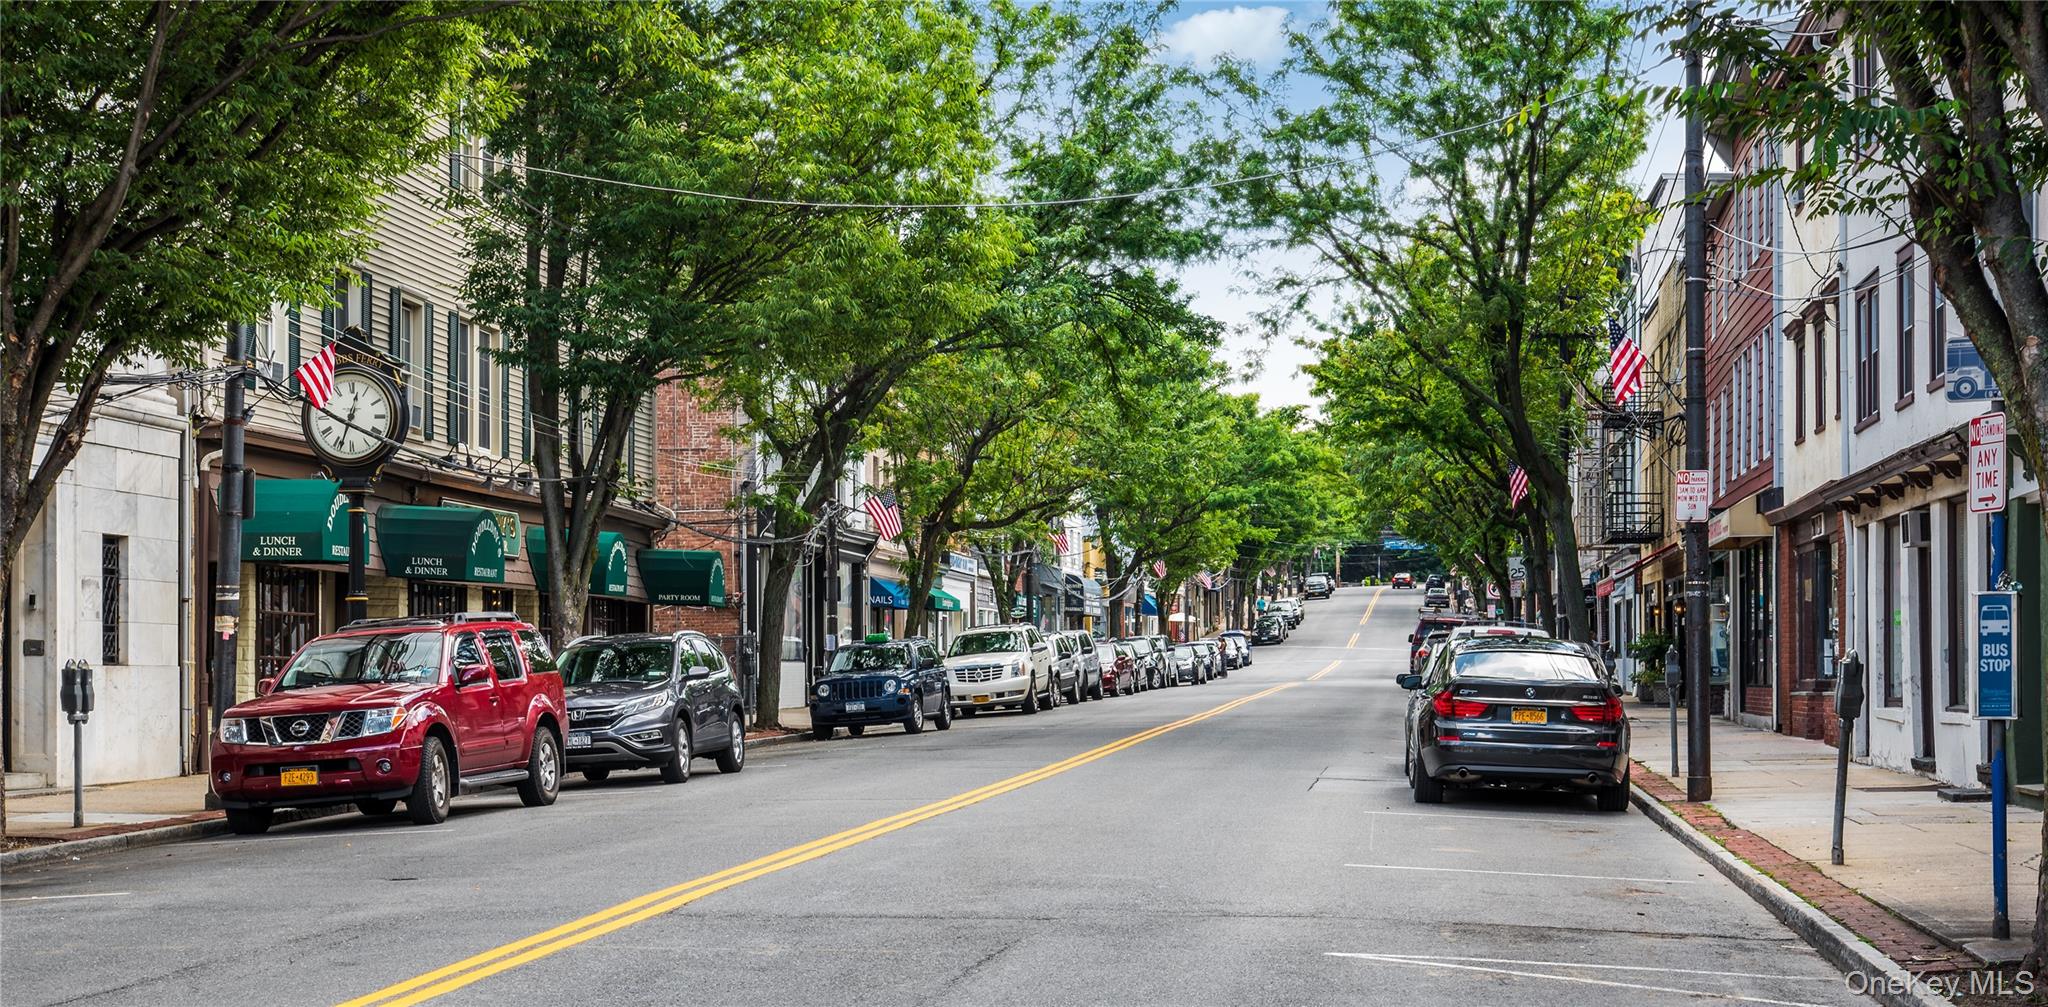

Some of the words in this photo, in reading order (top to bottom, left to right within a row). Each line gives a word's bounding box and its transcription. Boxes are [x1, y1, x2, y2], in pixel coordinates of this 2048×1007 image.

[356, 353, 384, 368] FERRY
[1971, 423, 1980, 442] NO
[1980, 423, 2004, 438] STANDING
[1977, 448, 1998, 468] ANY
[1677, 472, 1689, 483] NO
[1976, 470, 1998, 490] TIME
[260, 536, 296, 545] LUNCH
[252, 547, 261, 556] &
[263, 547, 303, 556] DINNER
[411, 557, 443, 566] LUNCH
[405, 566, 412, 575] &
[414, 566, 448, 576] DINNER
[1510, 567, 1526, 579] 25
[869, 595, 893, 605] NAILS
[1982, 643, 2008, 657] BUS
[1980, 659, 2011, 672] STOP
